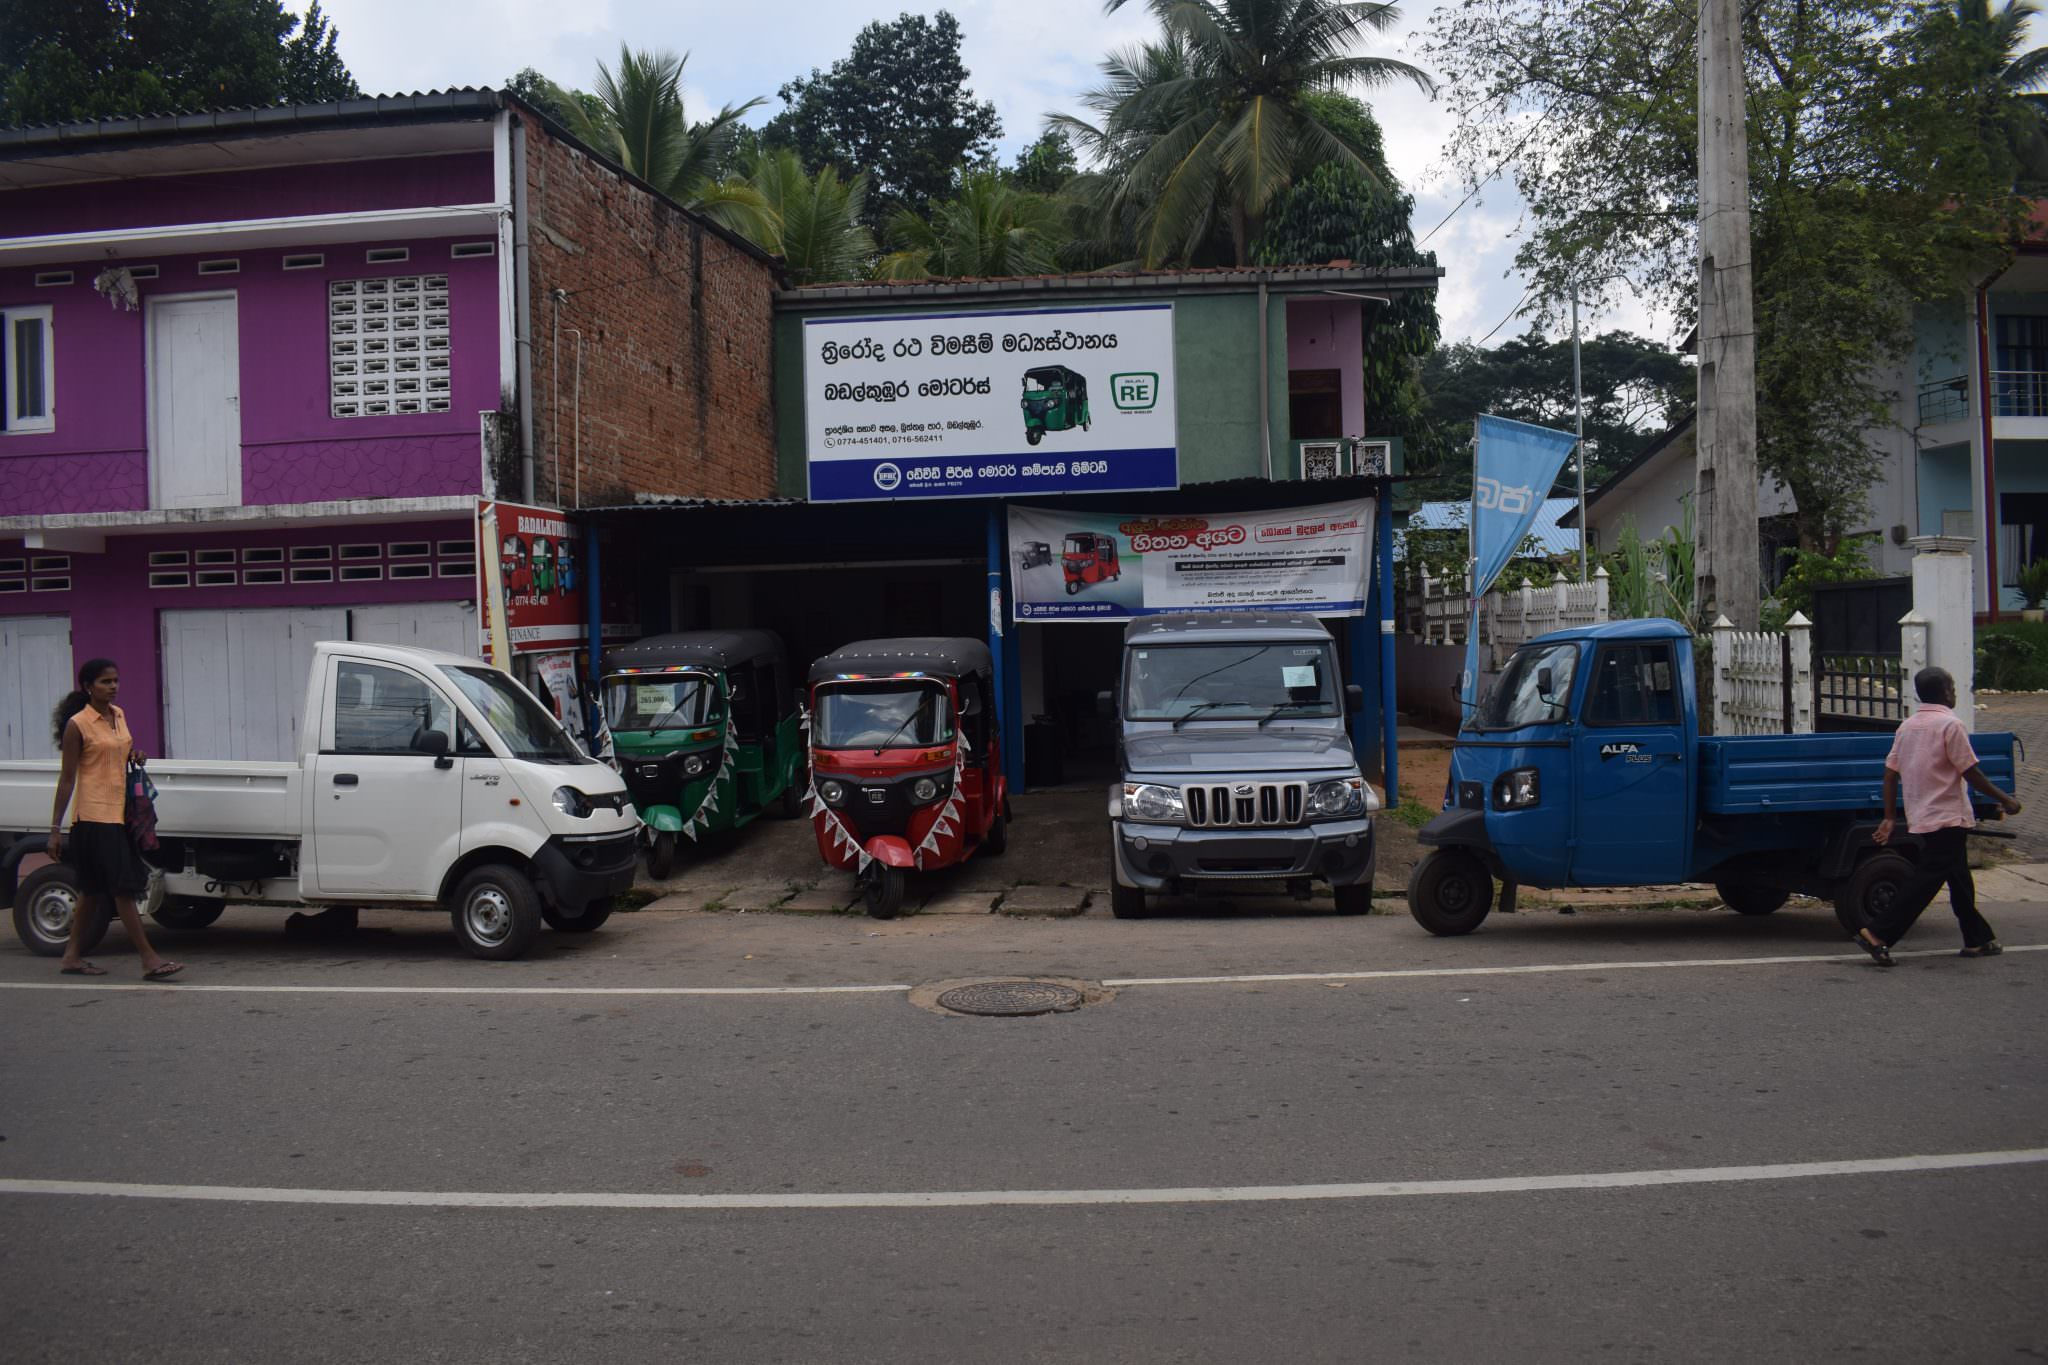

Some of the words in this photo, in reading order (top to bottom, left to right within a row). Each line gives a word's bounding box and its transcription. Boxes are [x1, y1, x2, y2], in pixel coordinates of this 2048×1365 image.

[893, 338, 922, 358] රථ
[1001, 329, 1118, 353] මධ්‍යස්ථානය
[824, 380, 910, 403] බඩල්කුඹුර
[917, 376, 992, 398] මෝටර්ස්
[1120, 385, 1149, 401] RE
[837, 437, 891, 446] 0774-451401,
[892, 435, 943, 443] 0716-562411
[1133, 534, 1188, 551] හිතන
[1195, 527, 1245, 550] අයට
[1601, 743, 1639, 754] ALFA
